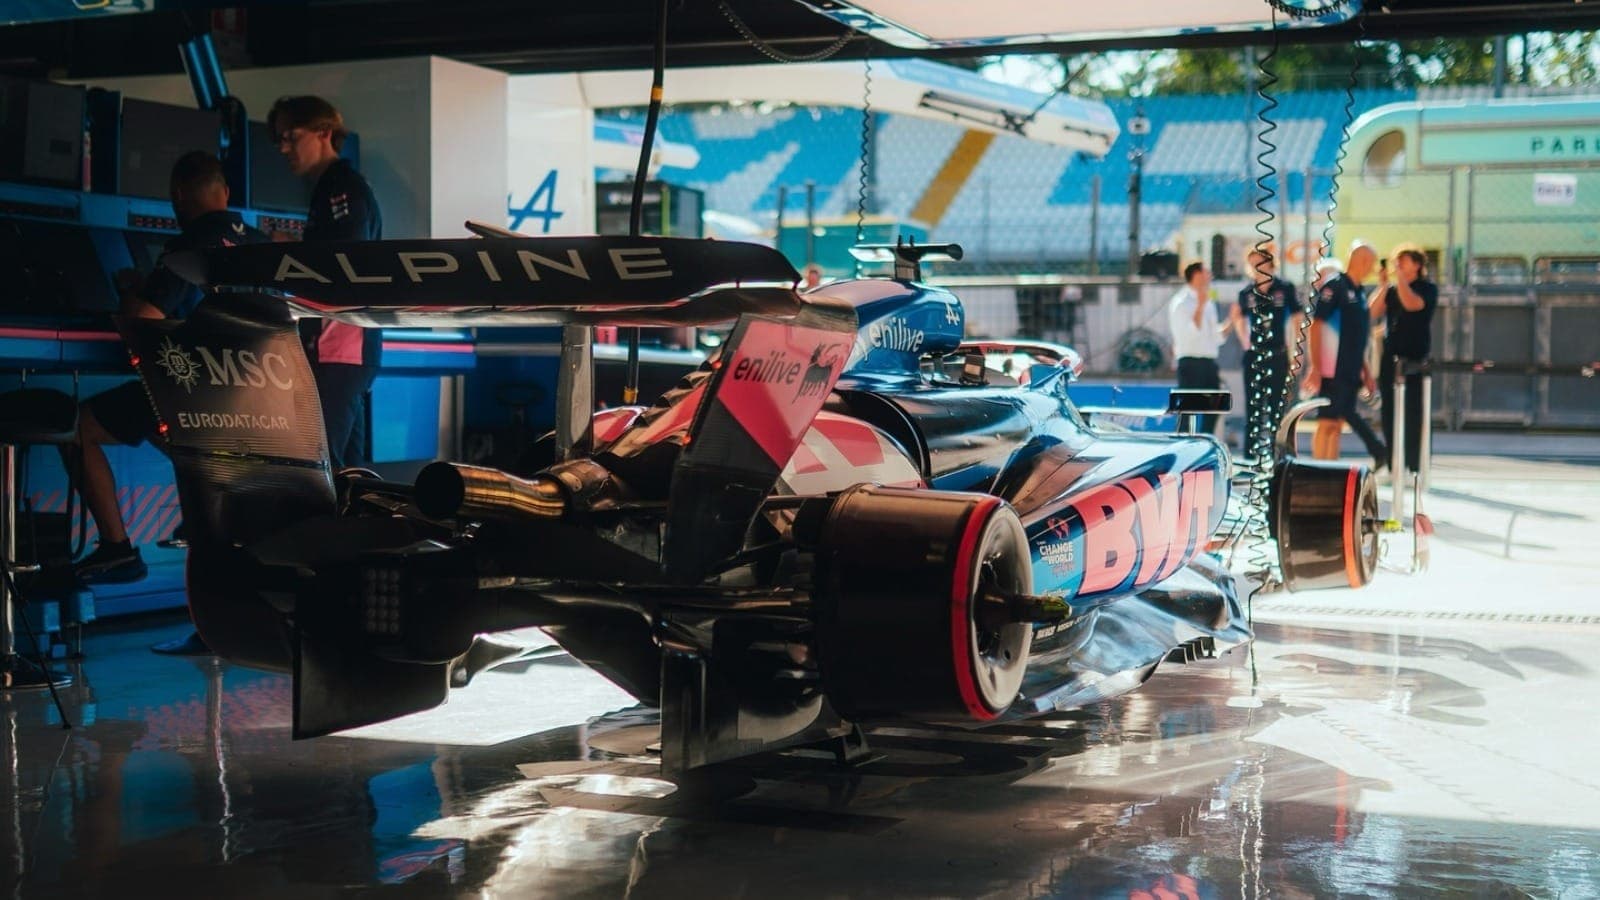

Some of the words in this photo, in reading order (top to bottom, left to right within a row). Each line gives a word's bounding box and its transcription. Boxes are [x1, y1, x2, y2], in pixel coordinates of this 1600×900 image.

[274, 247, 673, 283] ALPINE
[869, 317, 924, 352] enilive
[196, 346, 293, 390] MSC
[734, 351, 801, 384] enilive
[178, 413, 289, 430] EURODATACAR
[1040, 542, 1073, 555] CHANGE
[1074, 470, 1214, 595] BWT
[1048, 553, 1073, 565] WORLD
